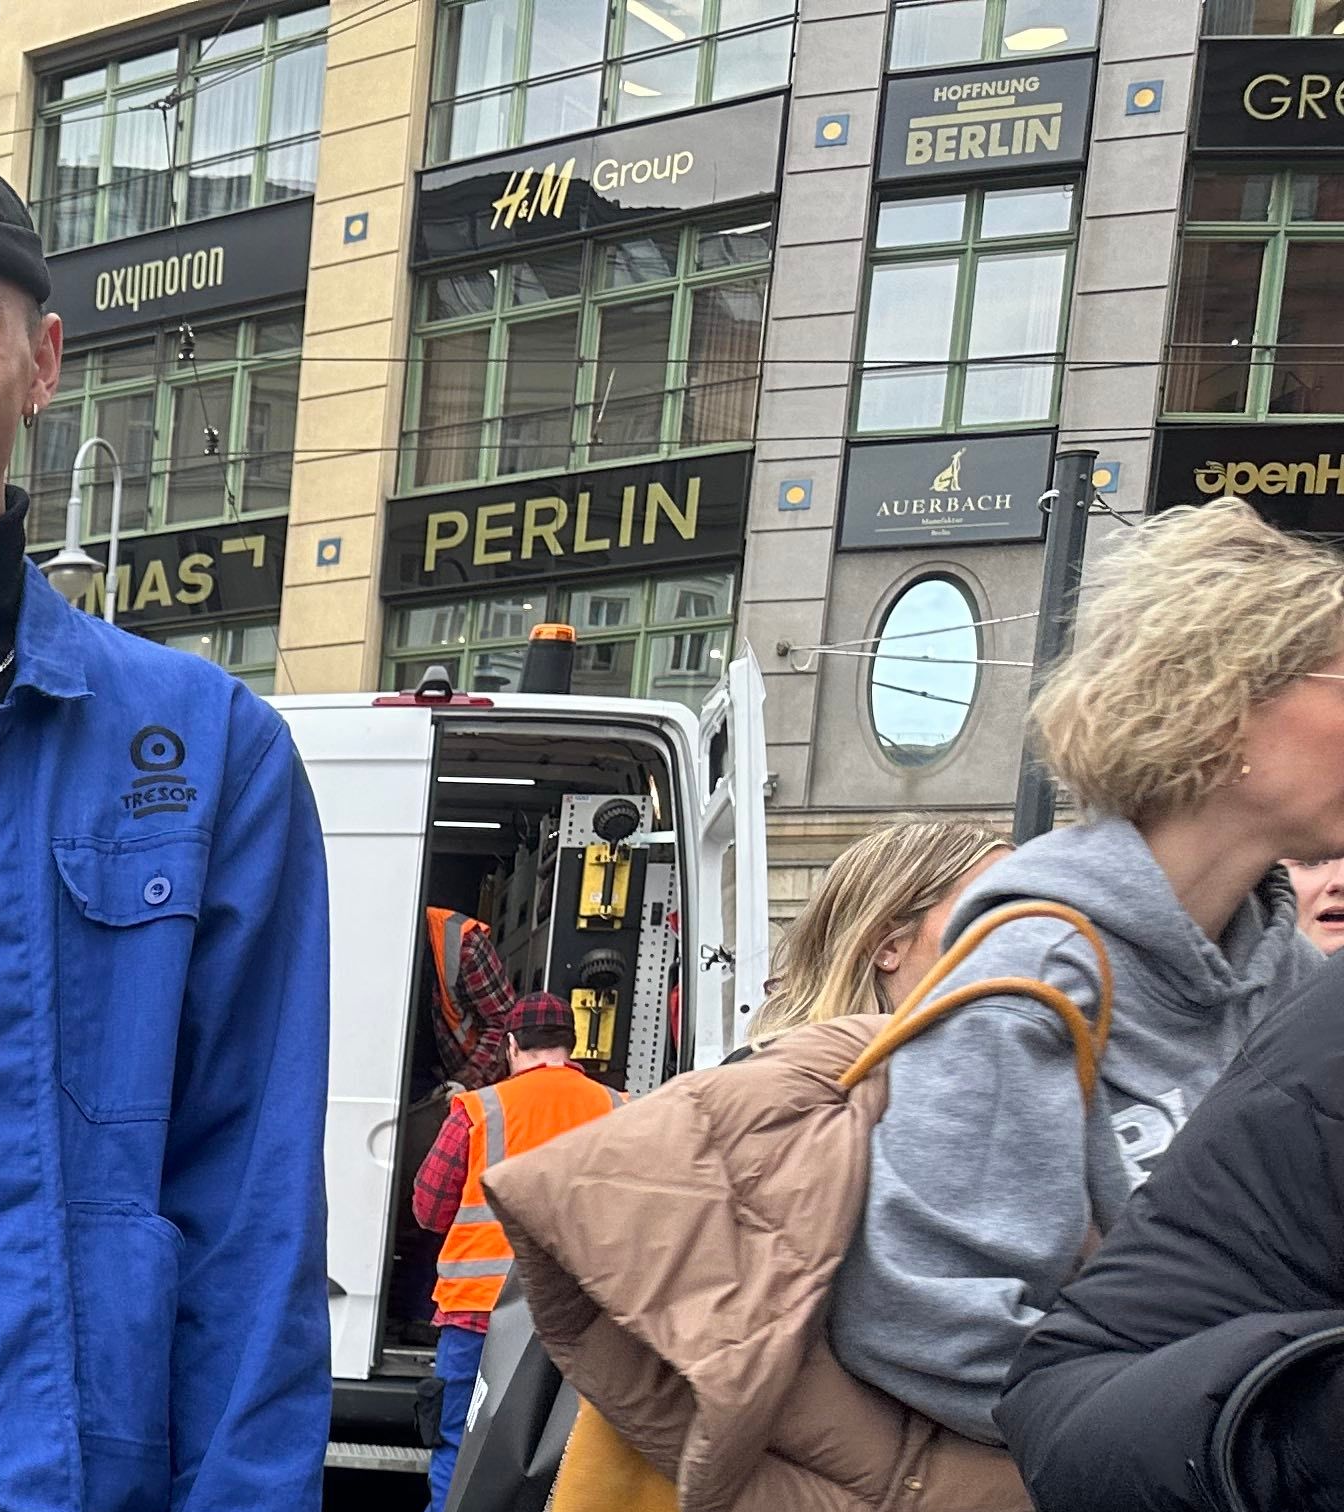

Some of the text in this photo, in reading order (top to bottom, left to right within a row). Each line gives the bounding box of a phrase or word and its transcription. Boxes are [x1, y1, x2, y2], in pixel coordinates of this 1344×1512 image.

[933, 77, 1040, 102] HOFFNUNG
[905, 115, 1062, 166] BERLIN
[490, 150, 694, 231] H&M Group
[95, 245, 225, 313] oxymoron
[424, 477, 701, 573] PERLIN
[876, 494, 1012, 517] AUERBACH
[120, 787, 197, 809] TRESOR
